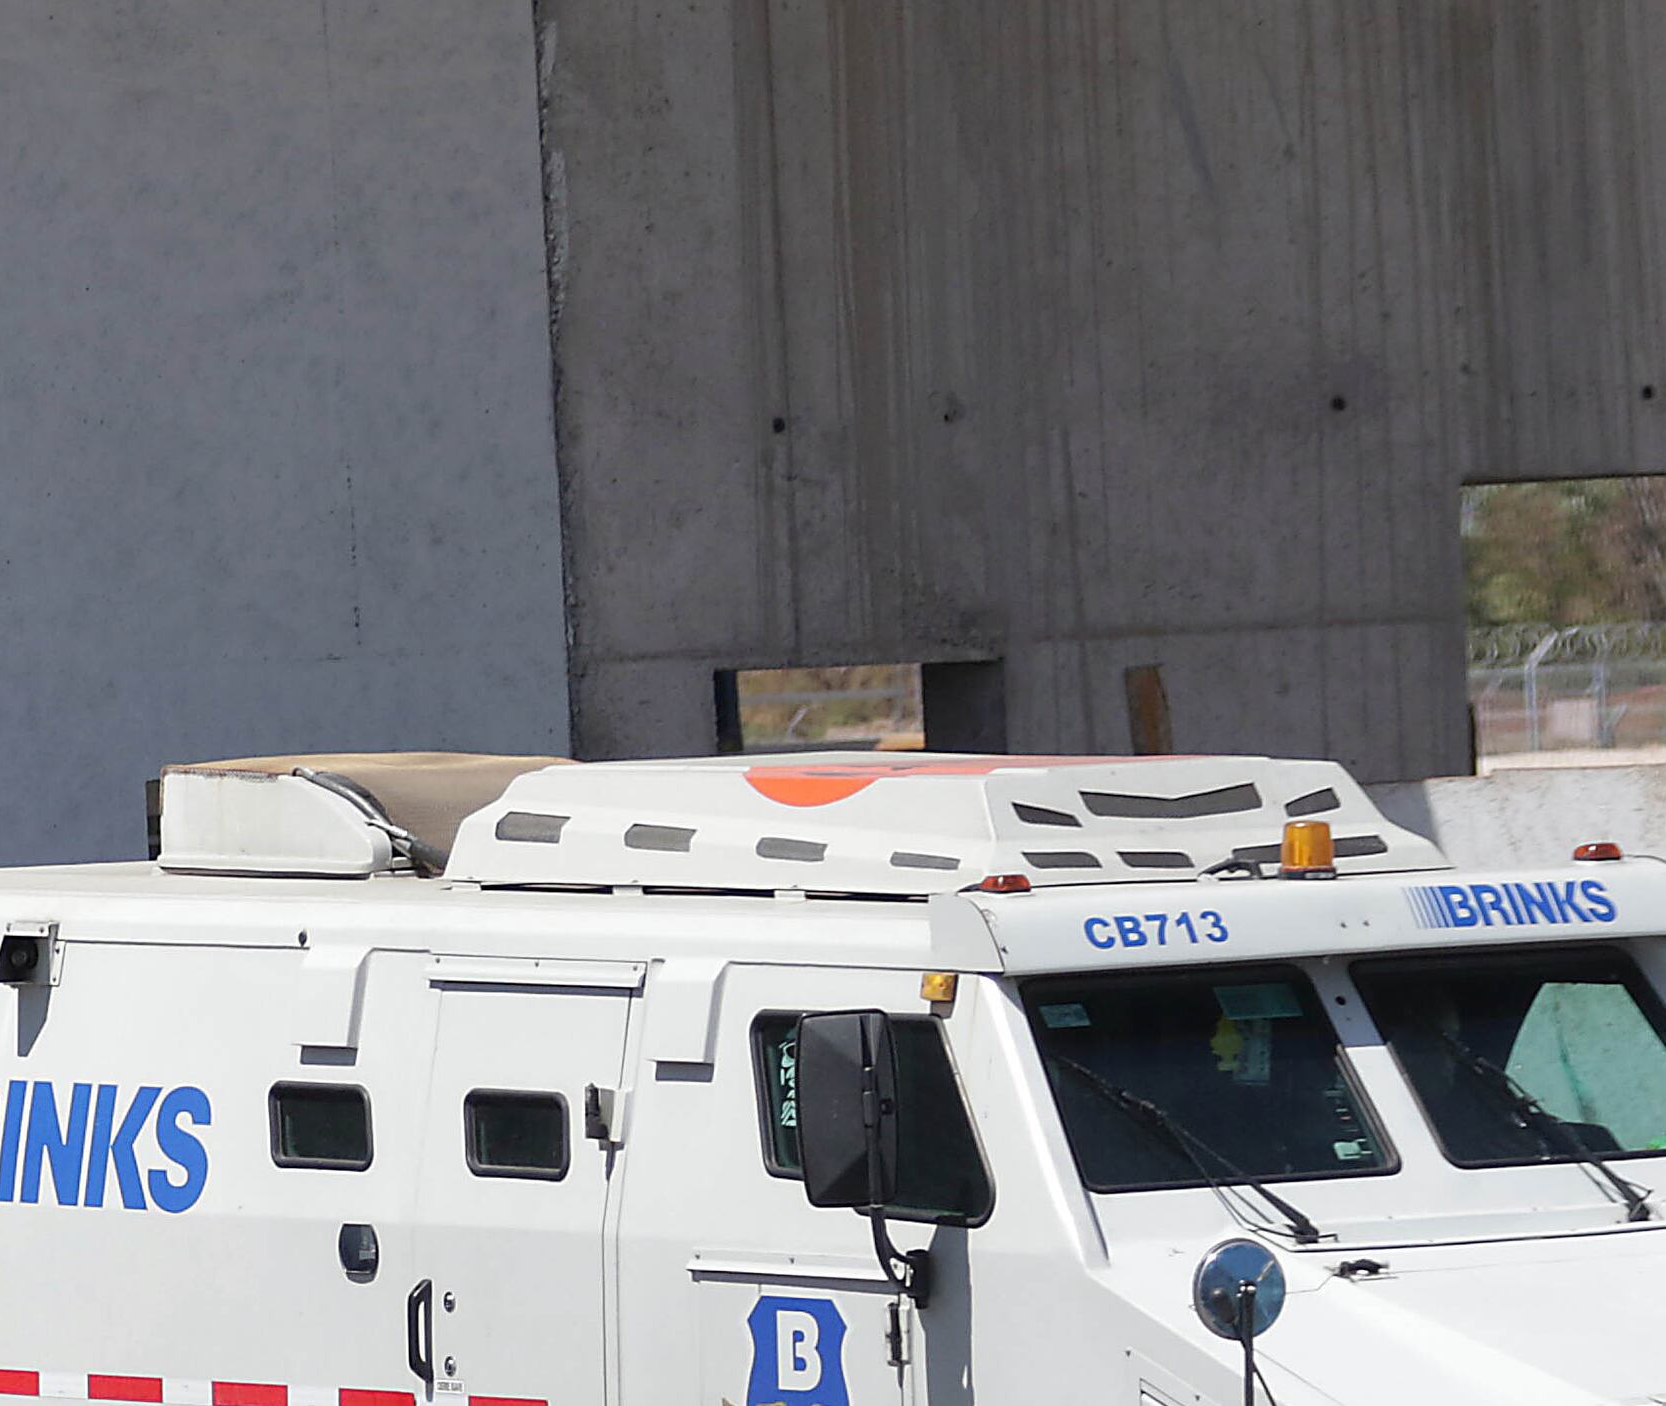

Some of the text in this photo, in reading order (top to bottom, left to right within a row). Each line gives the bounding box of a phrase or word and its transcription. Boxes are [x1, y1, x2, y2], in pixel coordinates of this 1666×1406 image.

[1438, 880, 1617, 928] BRINKS
[1084, 911, 1228, 949] CB713
[776, 1310, 822, 1391] B
